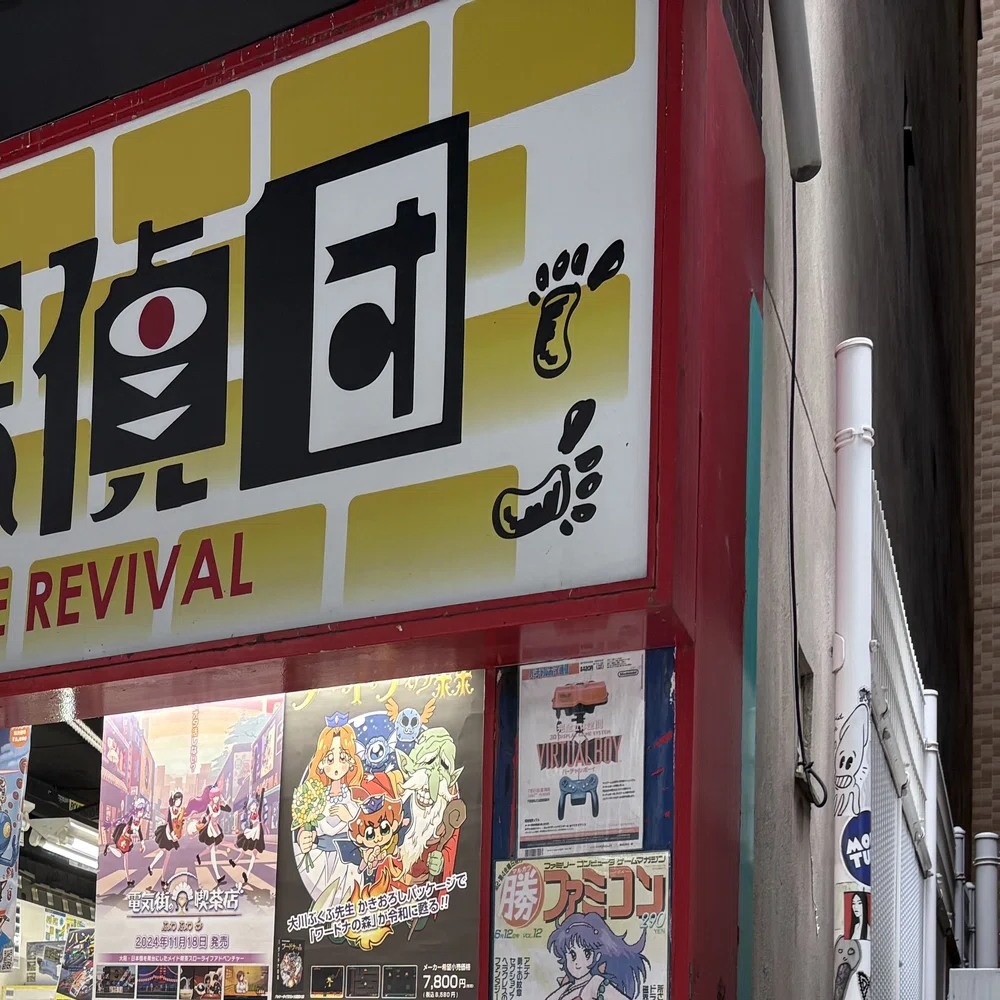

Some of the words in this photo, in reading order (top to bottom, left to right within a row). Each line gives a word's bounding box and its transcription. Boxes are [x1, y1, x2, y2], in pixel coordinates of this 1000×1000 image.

[27, 532, 254, 630] REVIVAL
[537, 740, 592, 770] VIRTUAL
[594, 735, 623, 765] BOY
[846, 833, 871, 855] MO
[358, 873, 468, 914] かきおろしパッケージで
[501, 868, 538, 921] 勝
[543, 865, 666, 923] ファミコン
[640, 912, 666, 928] 290
[135, 935, 209, 950] 2024年11月18日
[210, 935, 230, 949] 発売
[422, 975, 466, 990] 7,800円
